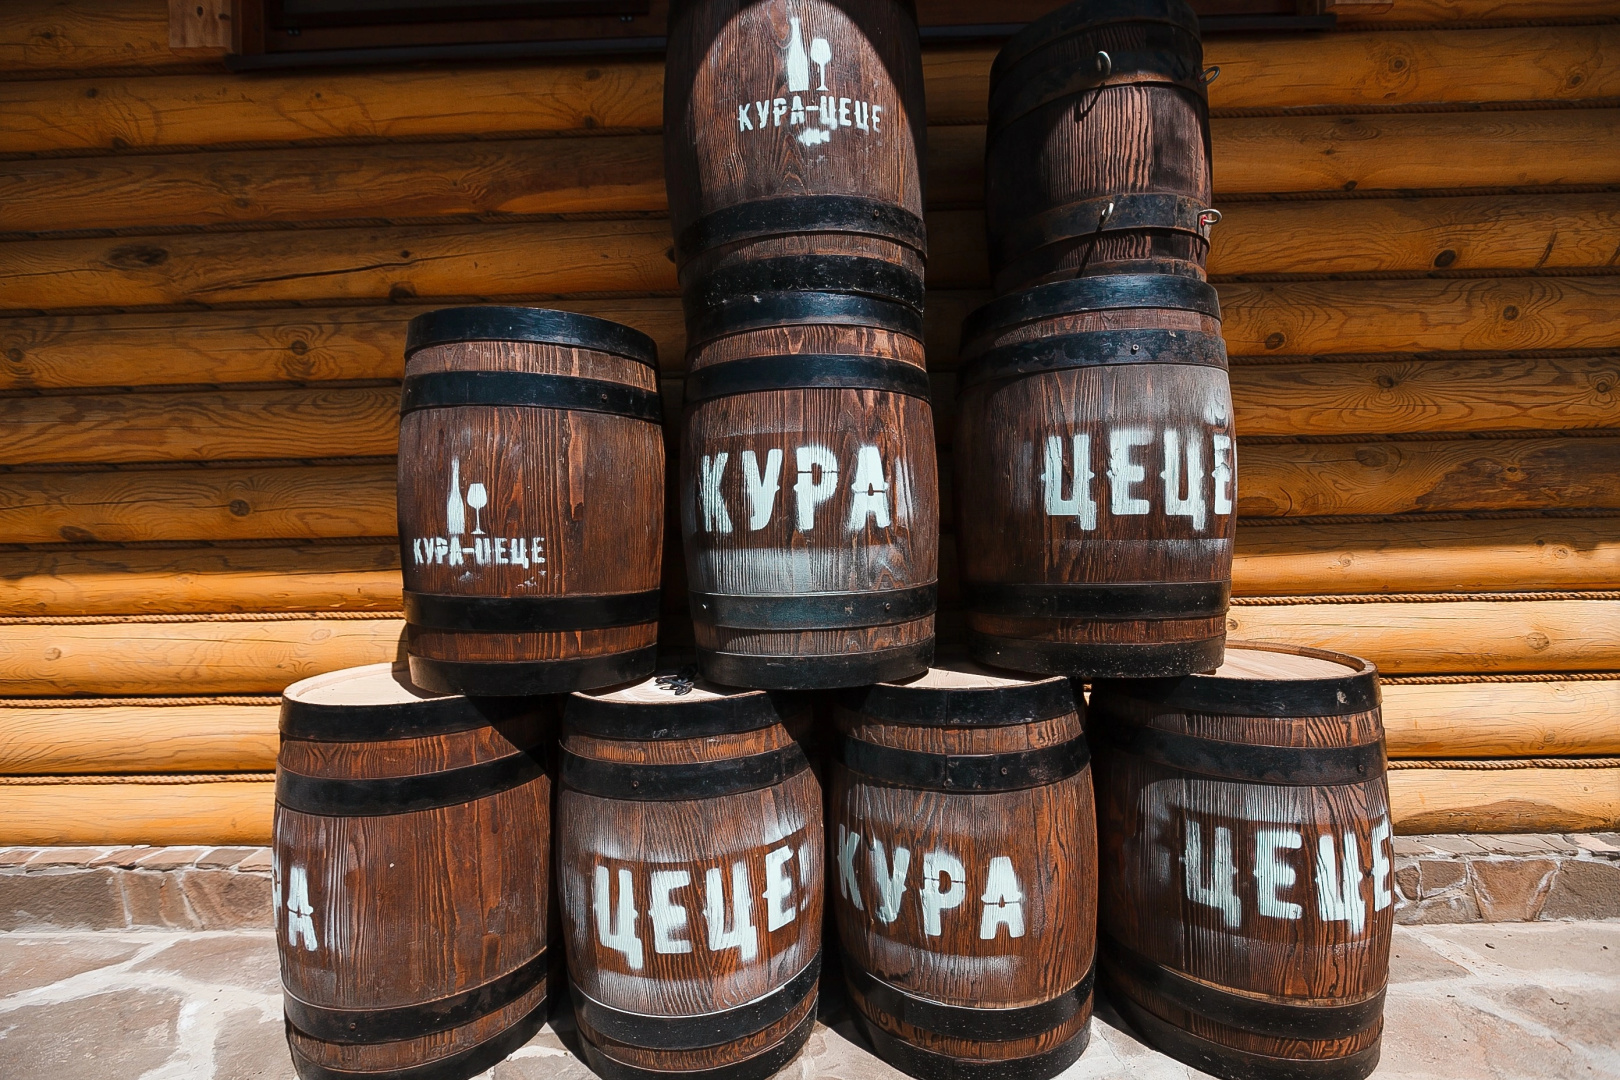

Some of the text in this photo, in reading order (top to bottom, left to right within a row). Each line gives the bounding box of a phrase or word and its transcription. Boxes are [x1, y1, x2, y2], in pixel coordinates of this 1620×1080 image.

[737, 95, 882, 134] КУРА-ЦЕЦЕ
[701, 444, 891, 534] КУРА
[1041, 426, 1232, 531] ЦЕЦЕ
[413, 536, 546, 569] КУРА-ЦЕЦЕ
[594, 845, 796, 970] ЦЕЦЕ
[837, 823, 1025, 940] КУРА
[1180, 816, 1392, 935] ЦЕЦЕ
